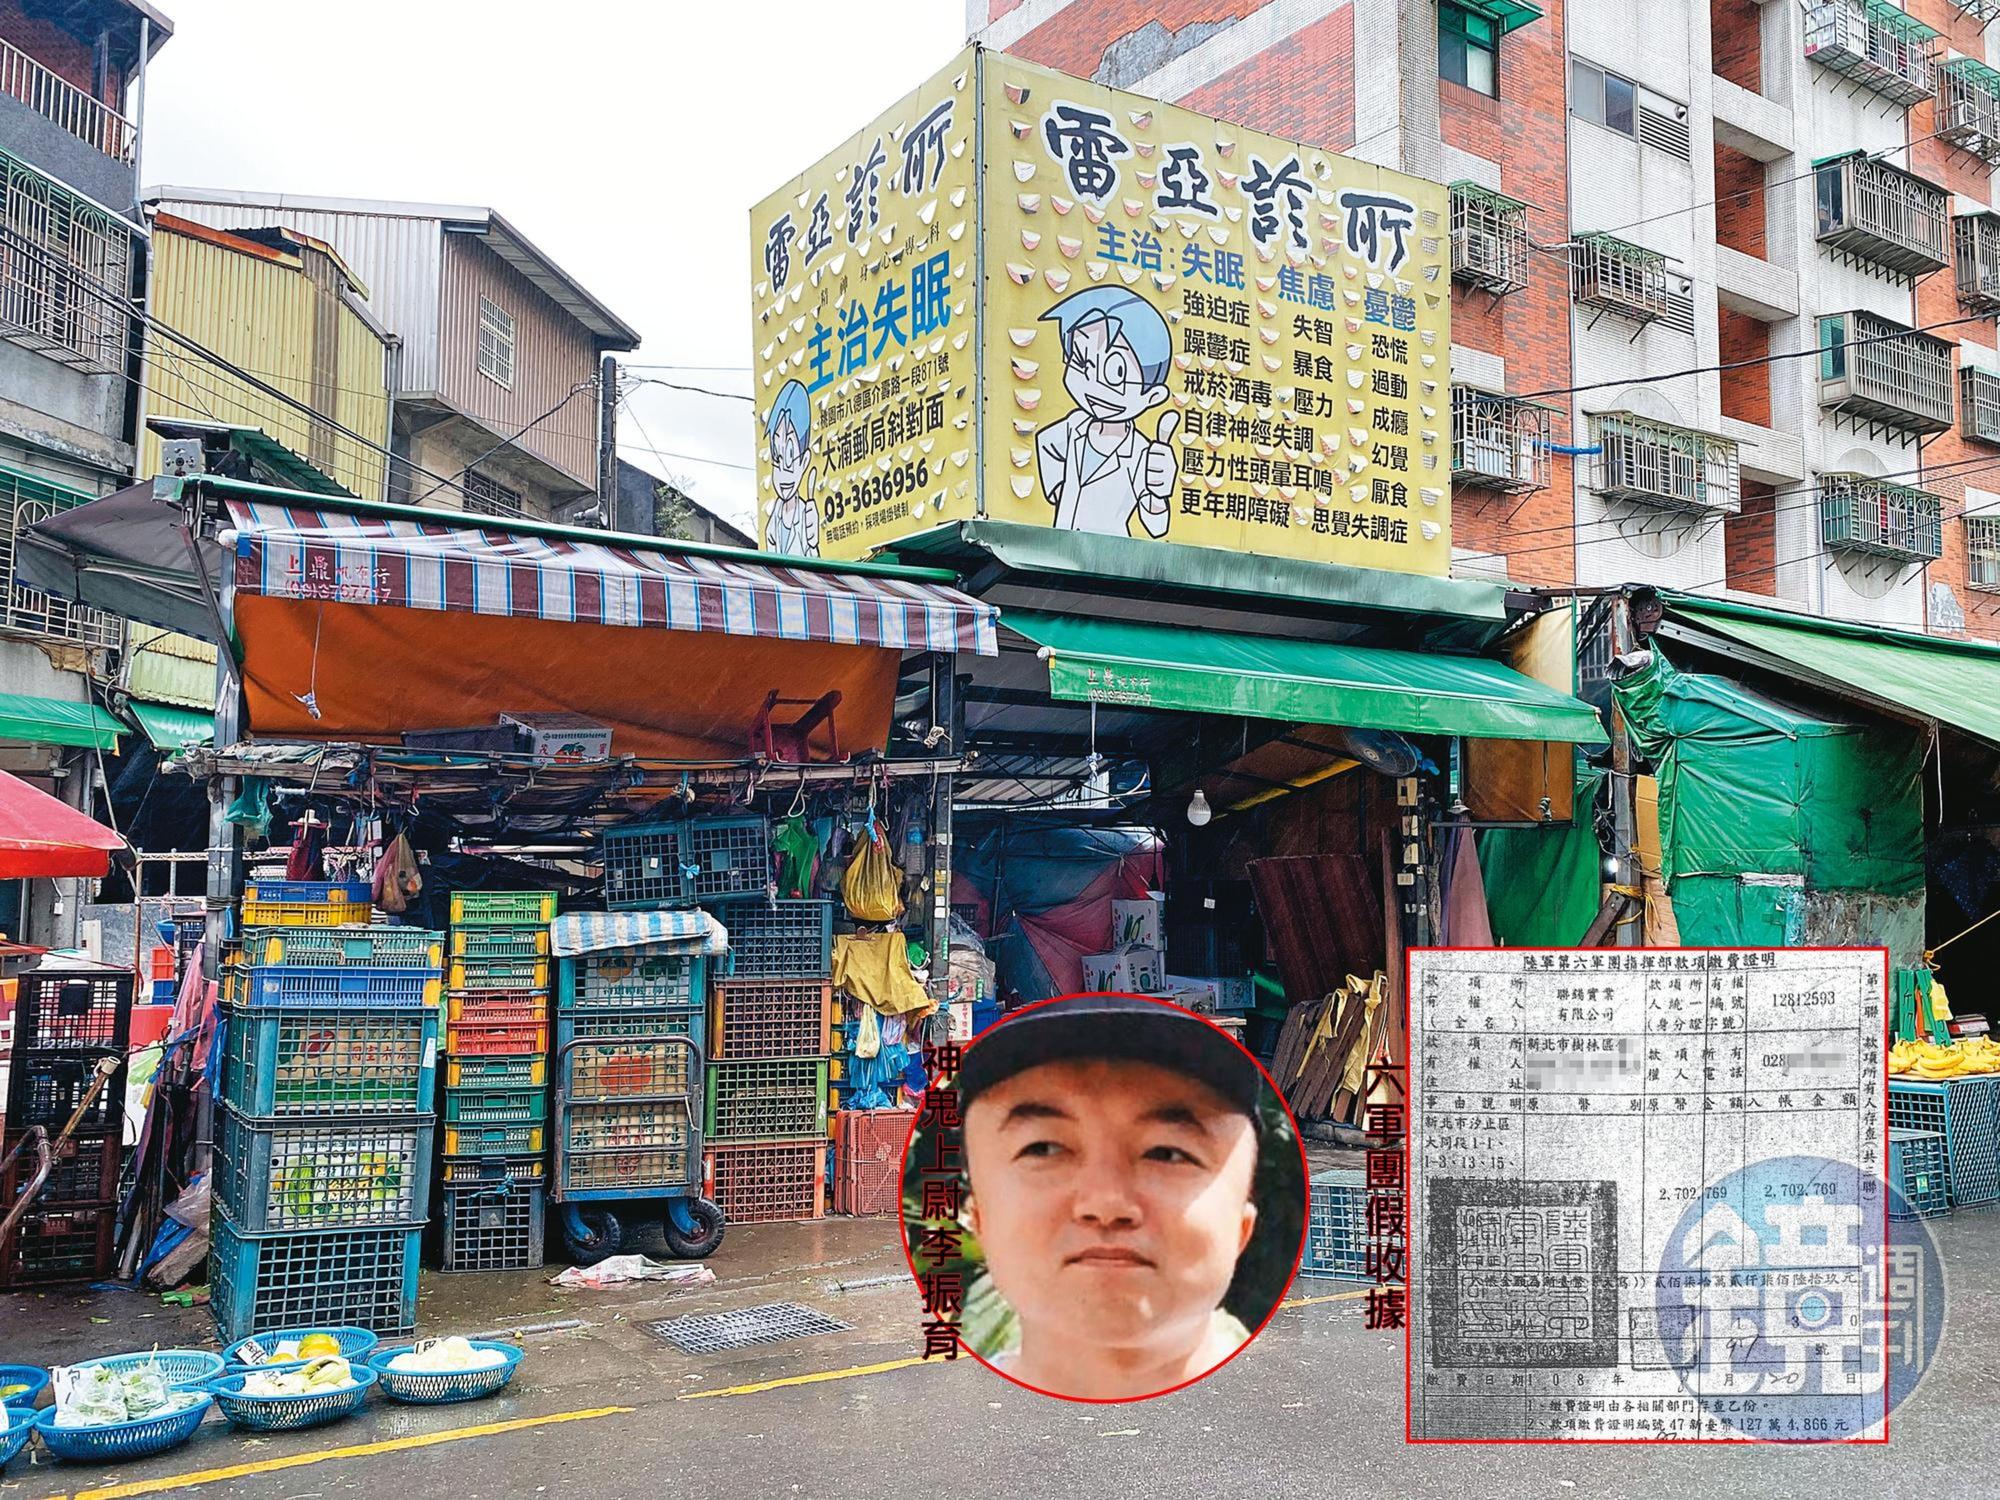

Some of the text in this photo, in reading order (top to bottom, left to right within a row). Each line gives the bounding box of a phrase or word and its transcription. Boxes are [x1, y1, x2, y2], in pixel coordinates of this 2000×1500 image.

[766, 100, 953, 293] 雷亞診所
[1045, 105, 1415, 272] 雷亞診所
[1183, 289, 1250, 327] 強迫症
[1276, 265, 1336, 312] 焦慮
[1363, 285, 1417, 333] 憂鬱
[808, 250, 952, 394] 主治失眠
[1293, 314, 1333, 346] 失智
[1183, 327, 1251, 366] 躁鬱症
[1371, 333, 1409, 365] 恐慌
[1293, 350, 1334, 383] 暴食
[1371, 368, 1408, 400] 過動
[1183, 369, 1272, 408] 戒菸酒毒
[1293, 388, 1333, 418] 壓力
[822, 392, 946, 476] 大湳郵局斜對面
[1184, 407, 1314, 453] 自律神經失調
[1372, 406, 1409, 436] 成癮
[1181, 447, 1333, 497] 壓力性頭暈耳鳴
[1372, 442, 1408, 472] 幻覺
[824, 458, 929, 523] 03-3636956
[1180, 487, 1290, 529] 更年期障礙
[1371, 478, 1408, 508] 厭食
[1311, 506, 1408, 544] 思覺失調症
